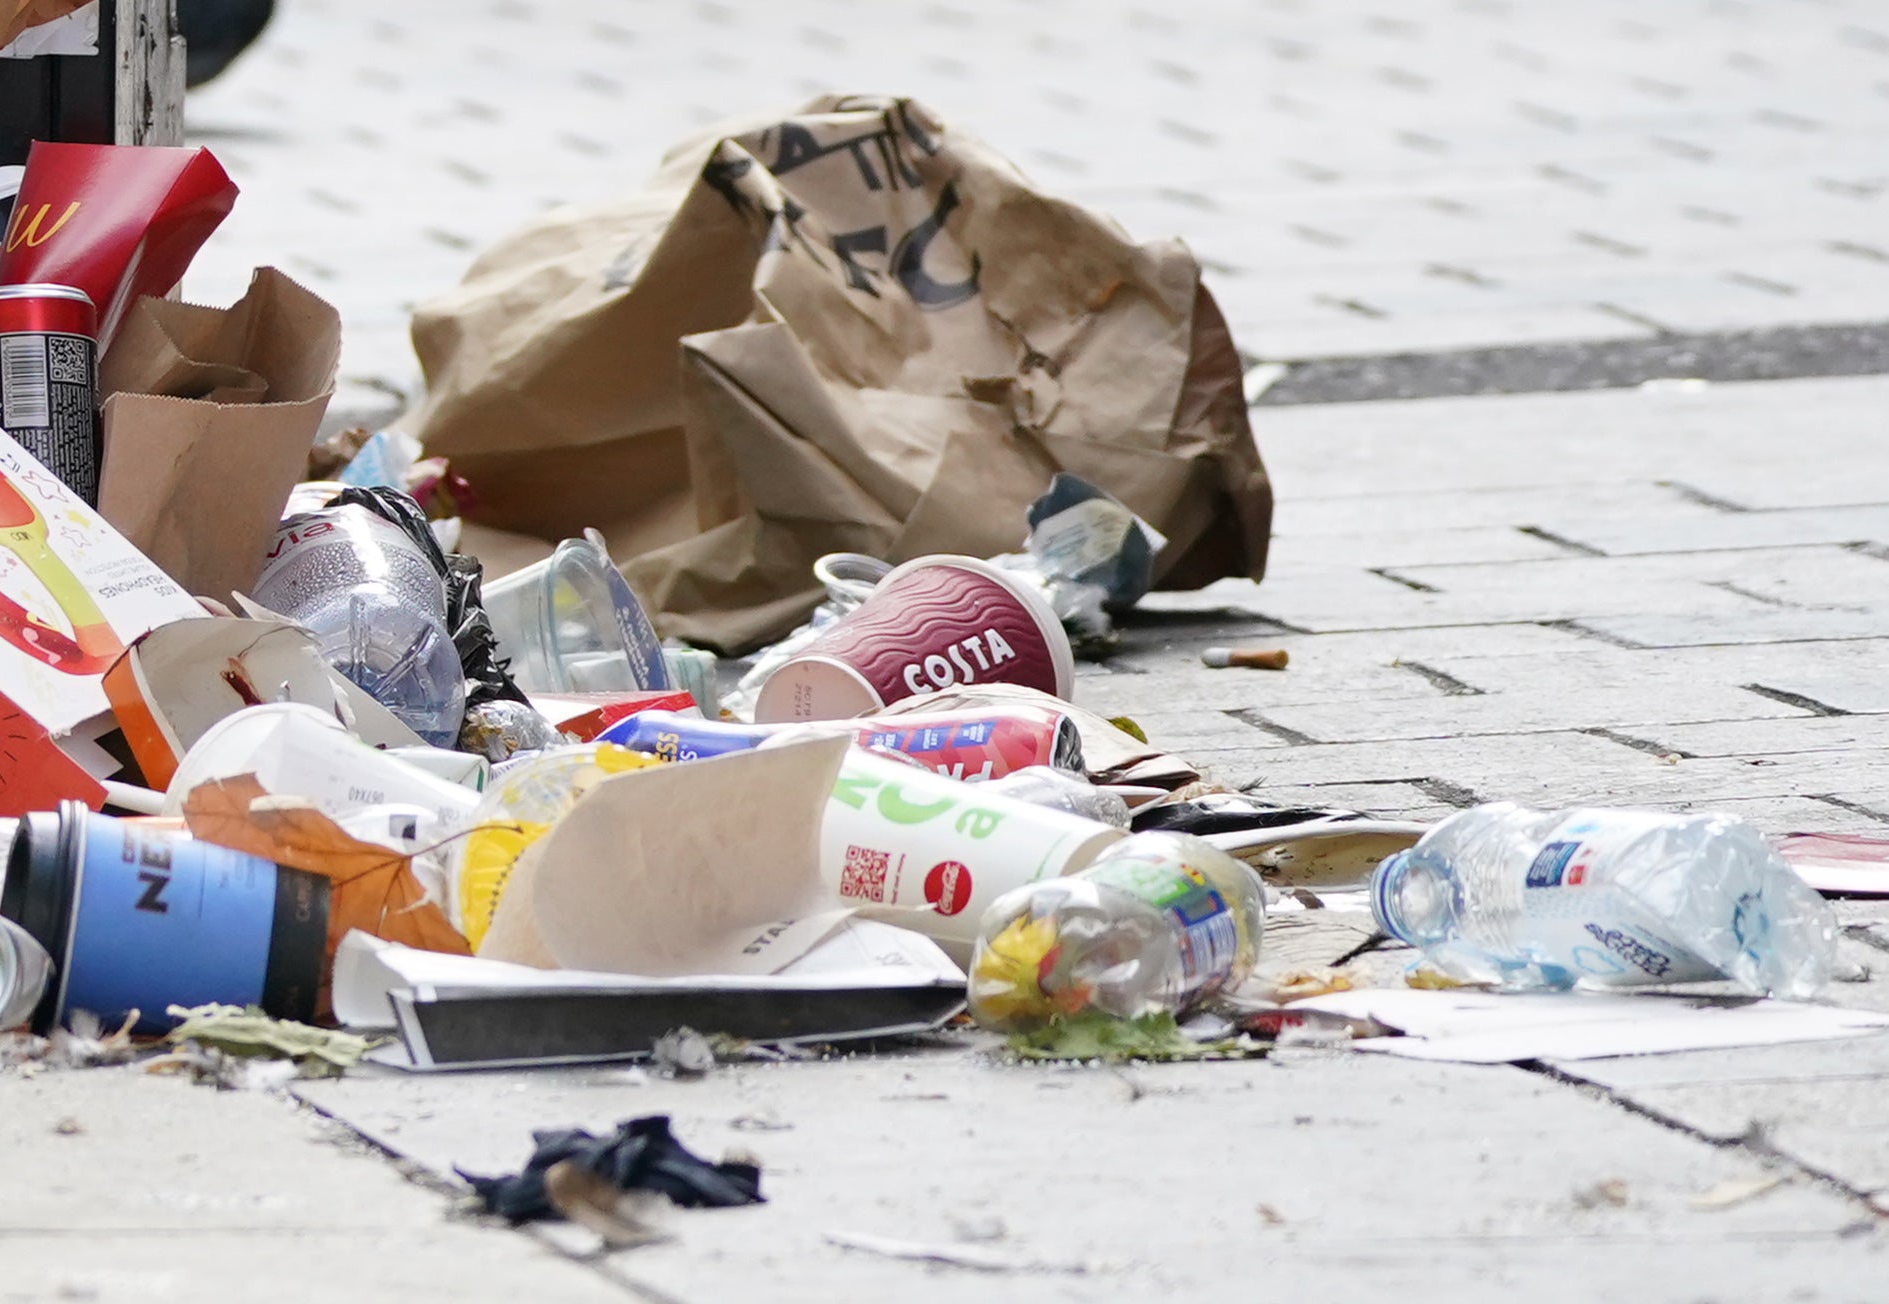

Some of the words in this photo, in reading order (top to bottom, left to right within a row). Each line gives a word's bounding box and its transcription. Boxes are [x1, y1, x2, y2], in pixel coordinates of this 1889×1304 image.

[99, 573, 165, 598] HEADPHONES
[157, 583, 177, 595] KIDS
[904, 628, 1016, 695] COSTA
